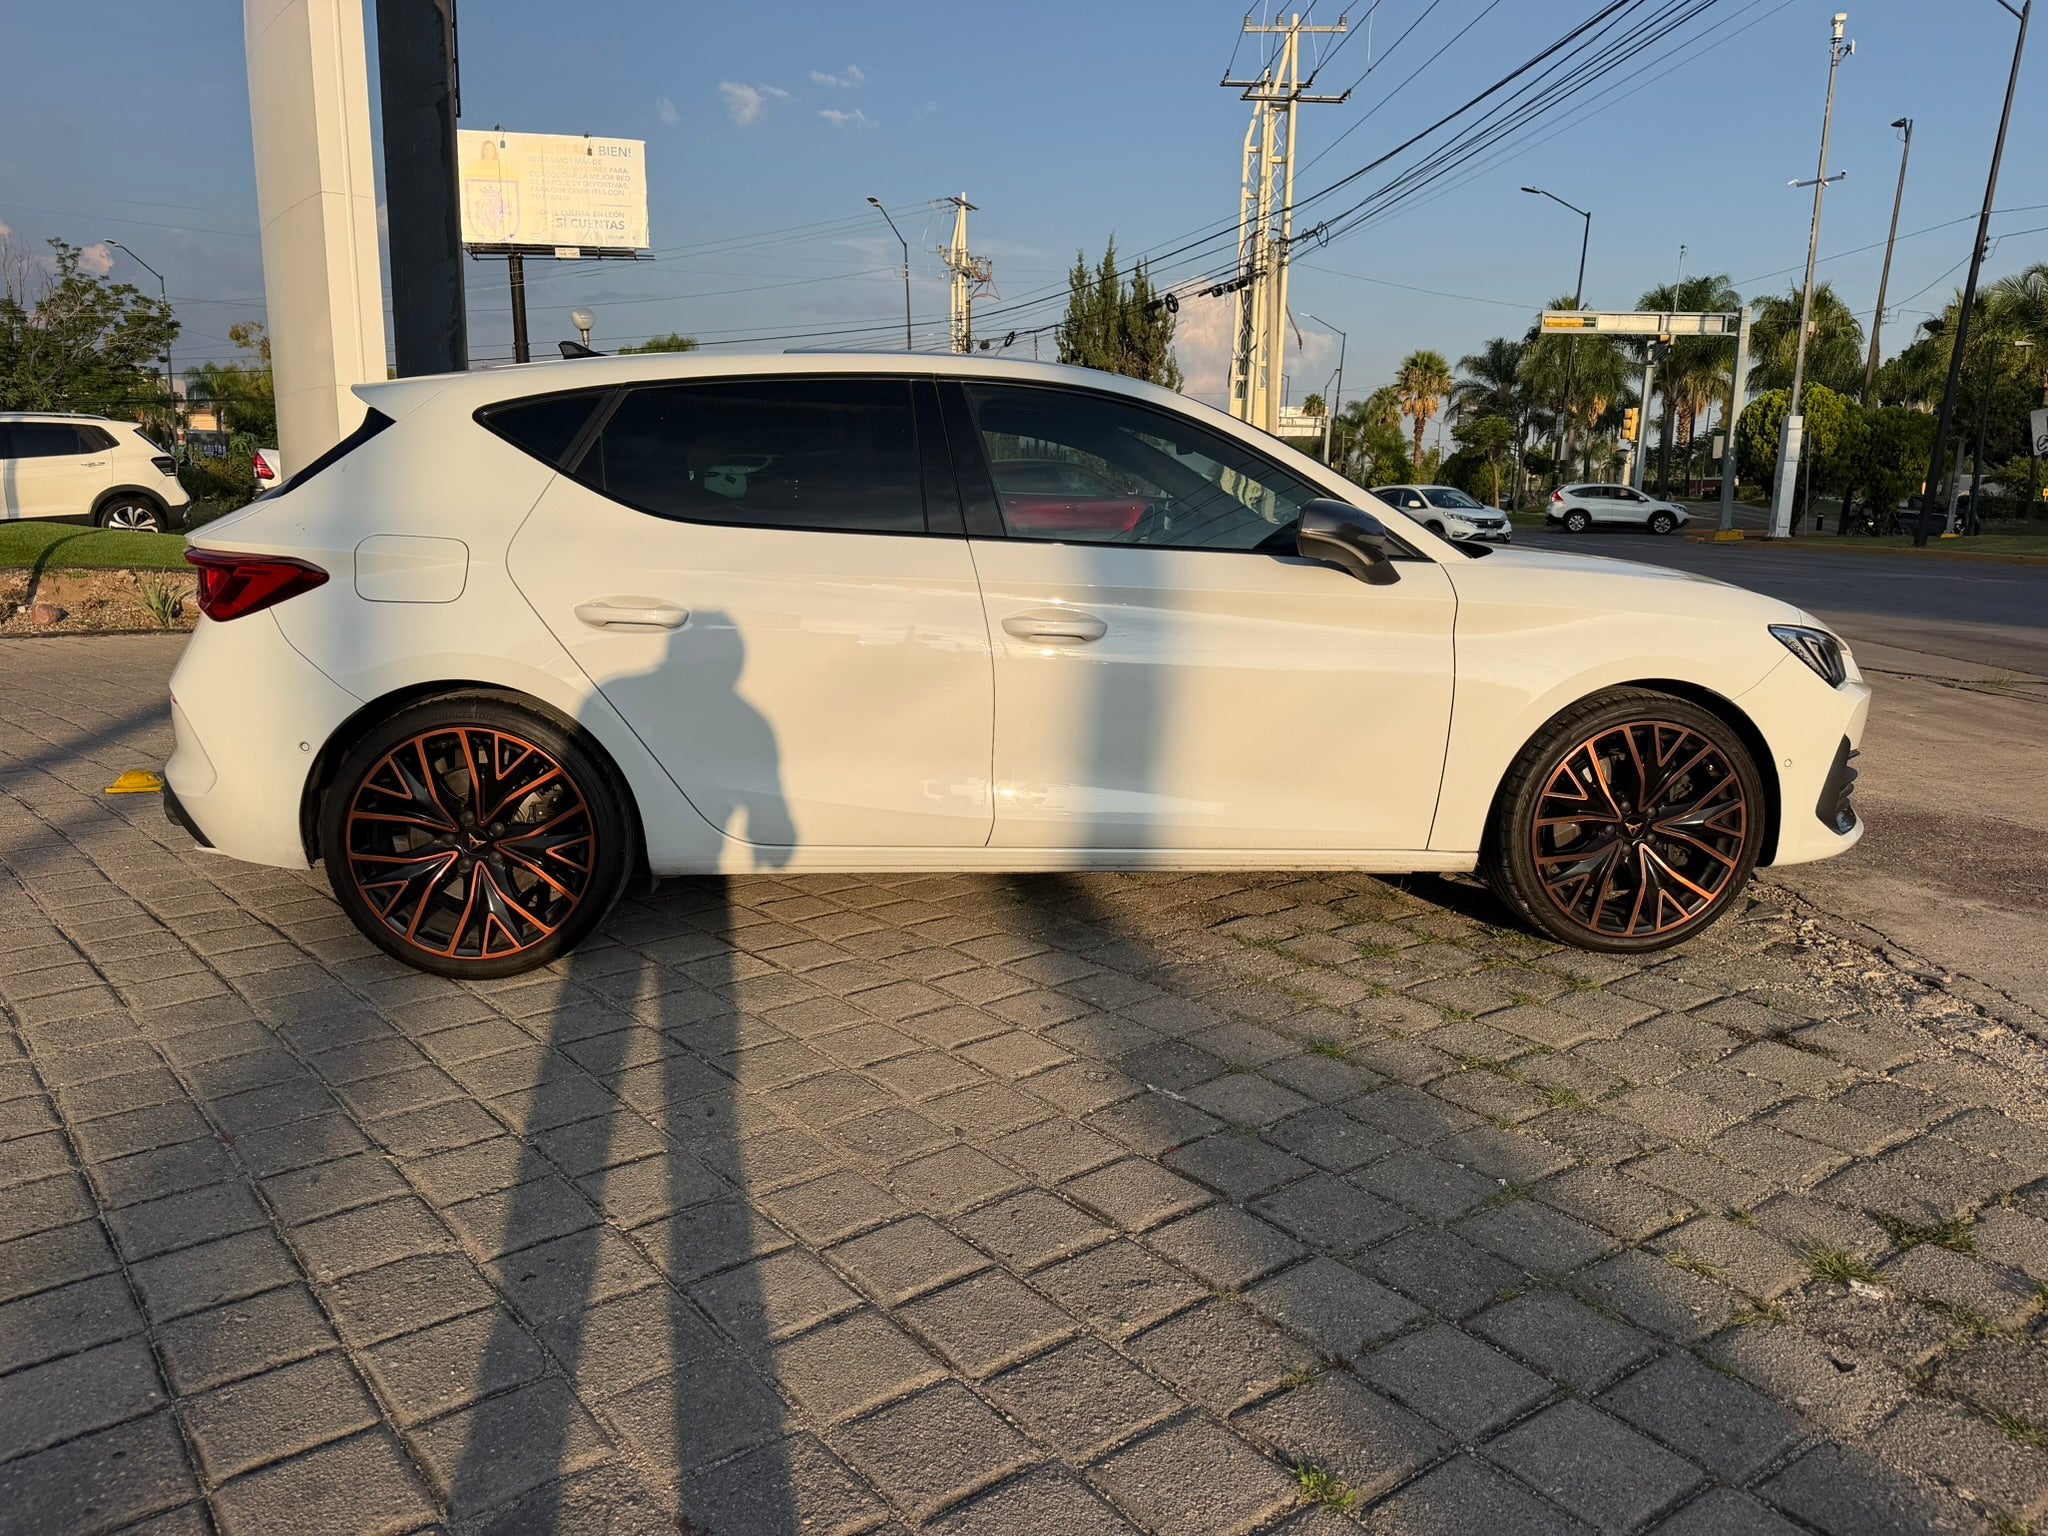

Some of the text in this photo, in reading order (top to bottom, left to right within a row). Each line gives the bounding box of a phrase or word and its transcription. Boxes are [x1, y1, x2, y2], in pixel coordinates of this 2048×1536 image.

[599, 146, 631, 157] BIEN!
[608, 189, 625, 197] CON
[605, 210, 625, 218] LEÓN
[575, 219, 625, 230] CUENTAS
